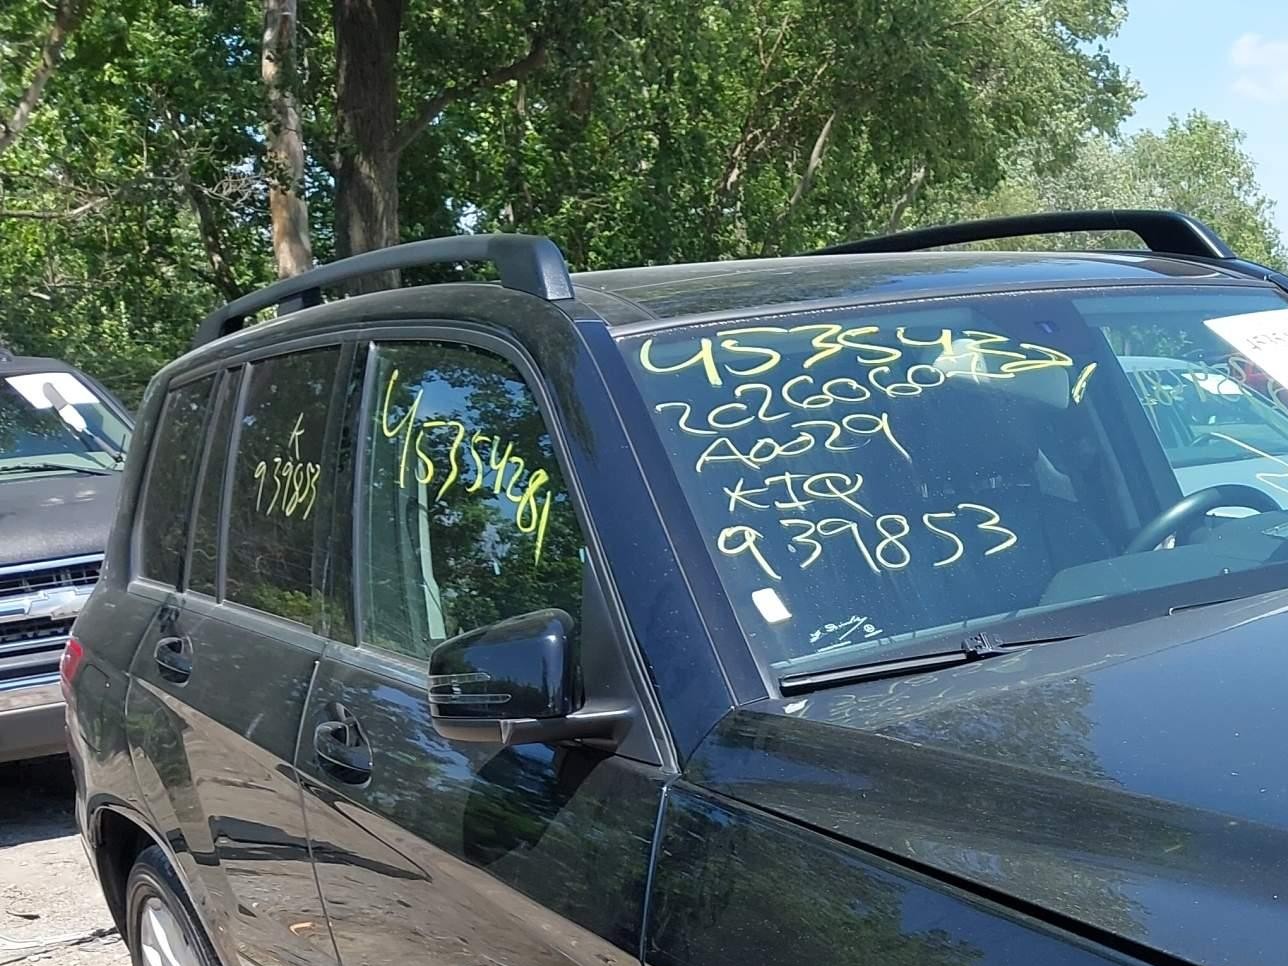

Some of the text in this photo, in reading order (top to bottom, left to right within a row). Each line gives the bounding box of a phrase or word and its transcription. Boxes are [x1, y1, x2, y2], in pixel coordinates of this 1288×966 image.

[288, 412, 305, 460] K
[383, 369, 550, 566] 45354281
[254, 457, 321, 520] 939853
[717, 503, 1018, 580] 939853
